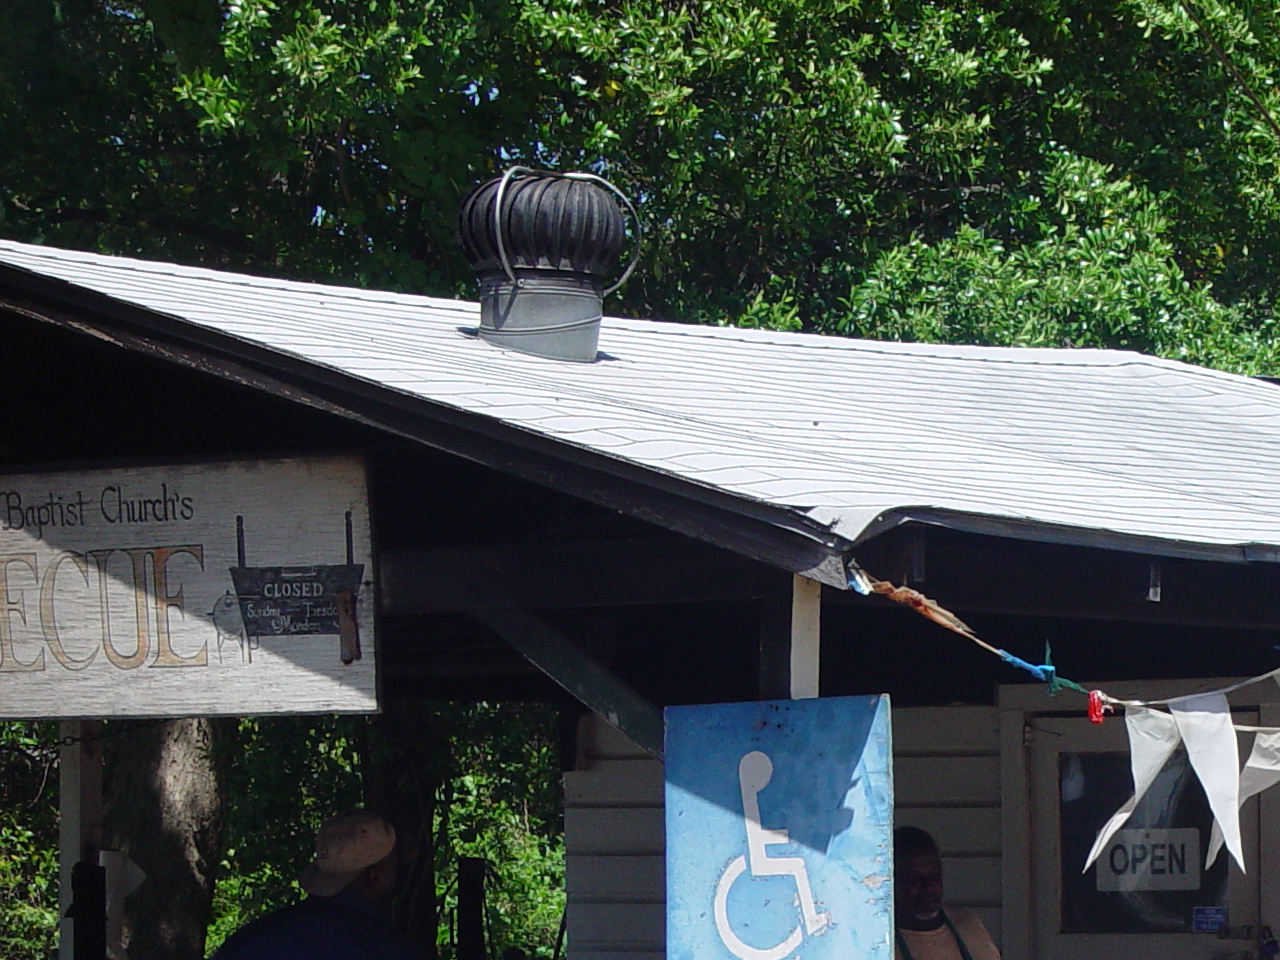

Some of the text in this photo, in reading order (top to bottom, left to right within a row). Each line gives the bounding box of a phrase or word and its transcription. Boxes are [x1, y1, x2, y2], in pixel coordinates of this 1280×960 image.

[0, 483, 194, 541] Baptist Church's
[263, 582, 323, 597] CLOSED
[302, 601, 339, 618] Tuesd
[1109, 843, 1186, 876] OPEN
